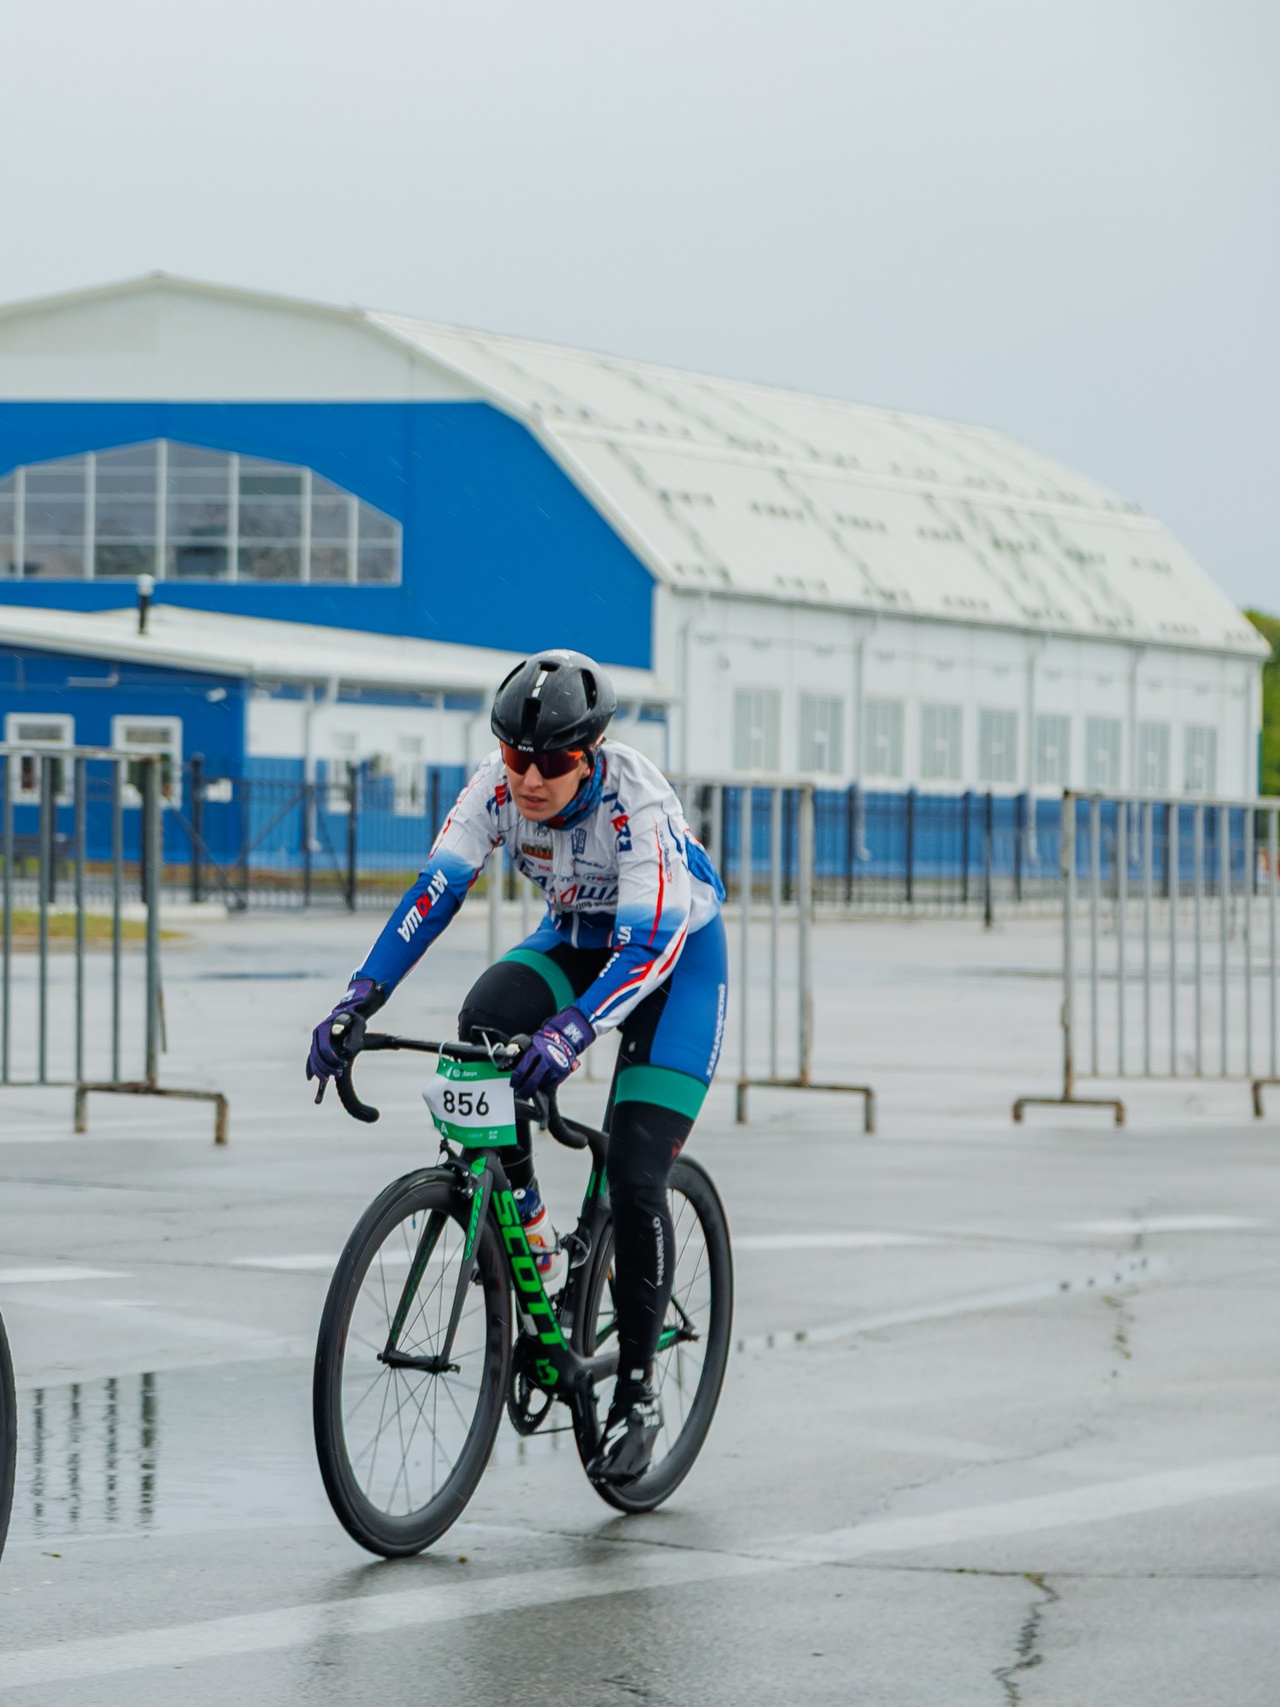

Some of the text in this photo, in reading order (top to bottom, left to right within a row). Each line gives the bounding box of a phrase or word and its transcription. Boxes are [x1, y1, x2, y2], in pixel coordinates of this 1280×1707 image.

[397, 869, 449, 943] КАТЮША
[443, 1089, 490, 1116] 856
[493, 1189, 569, 1352] SCOTT
